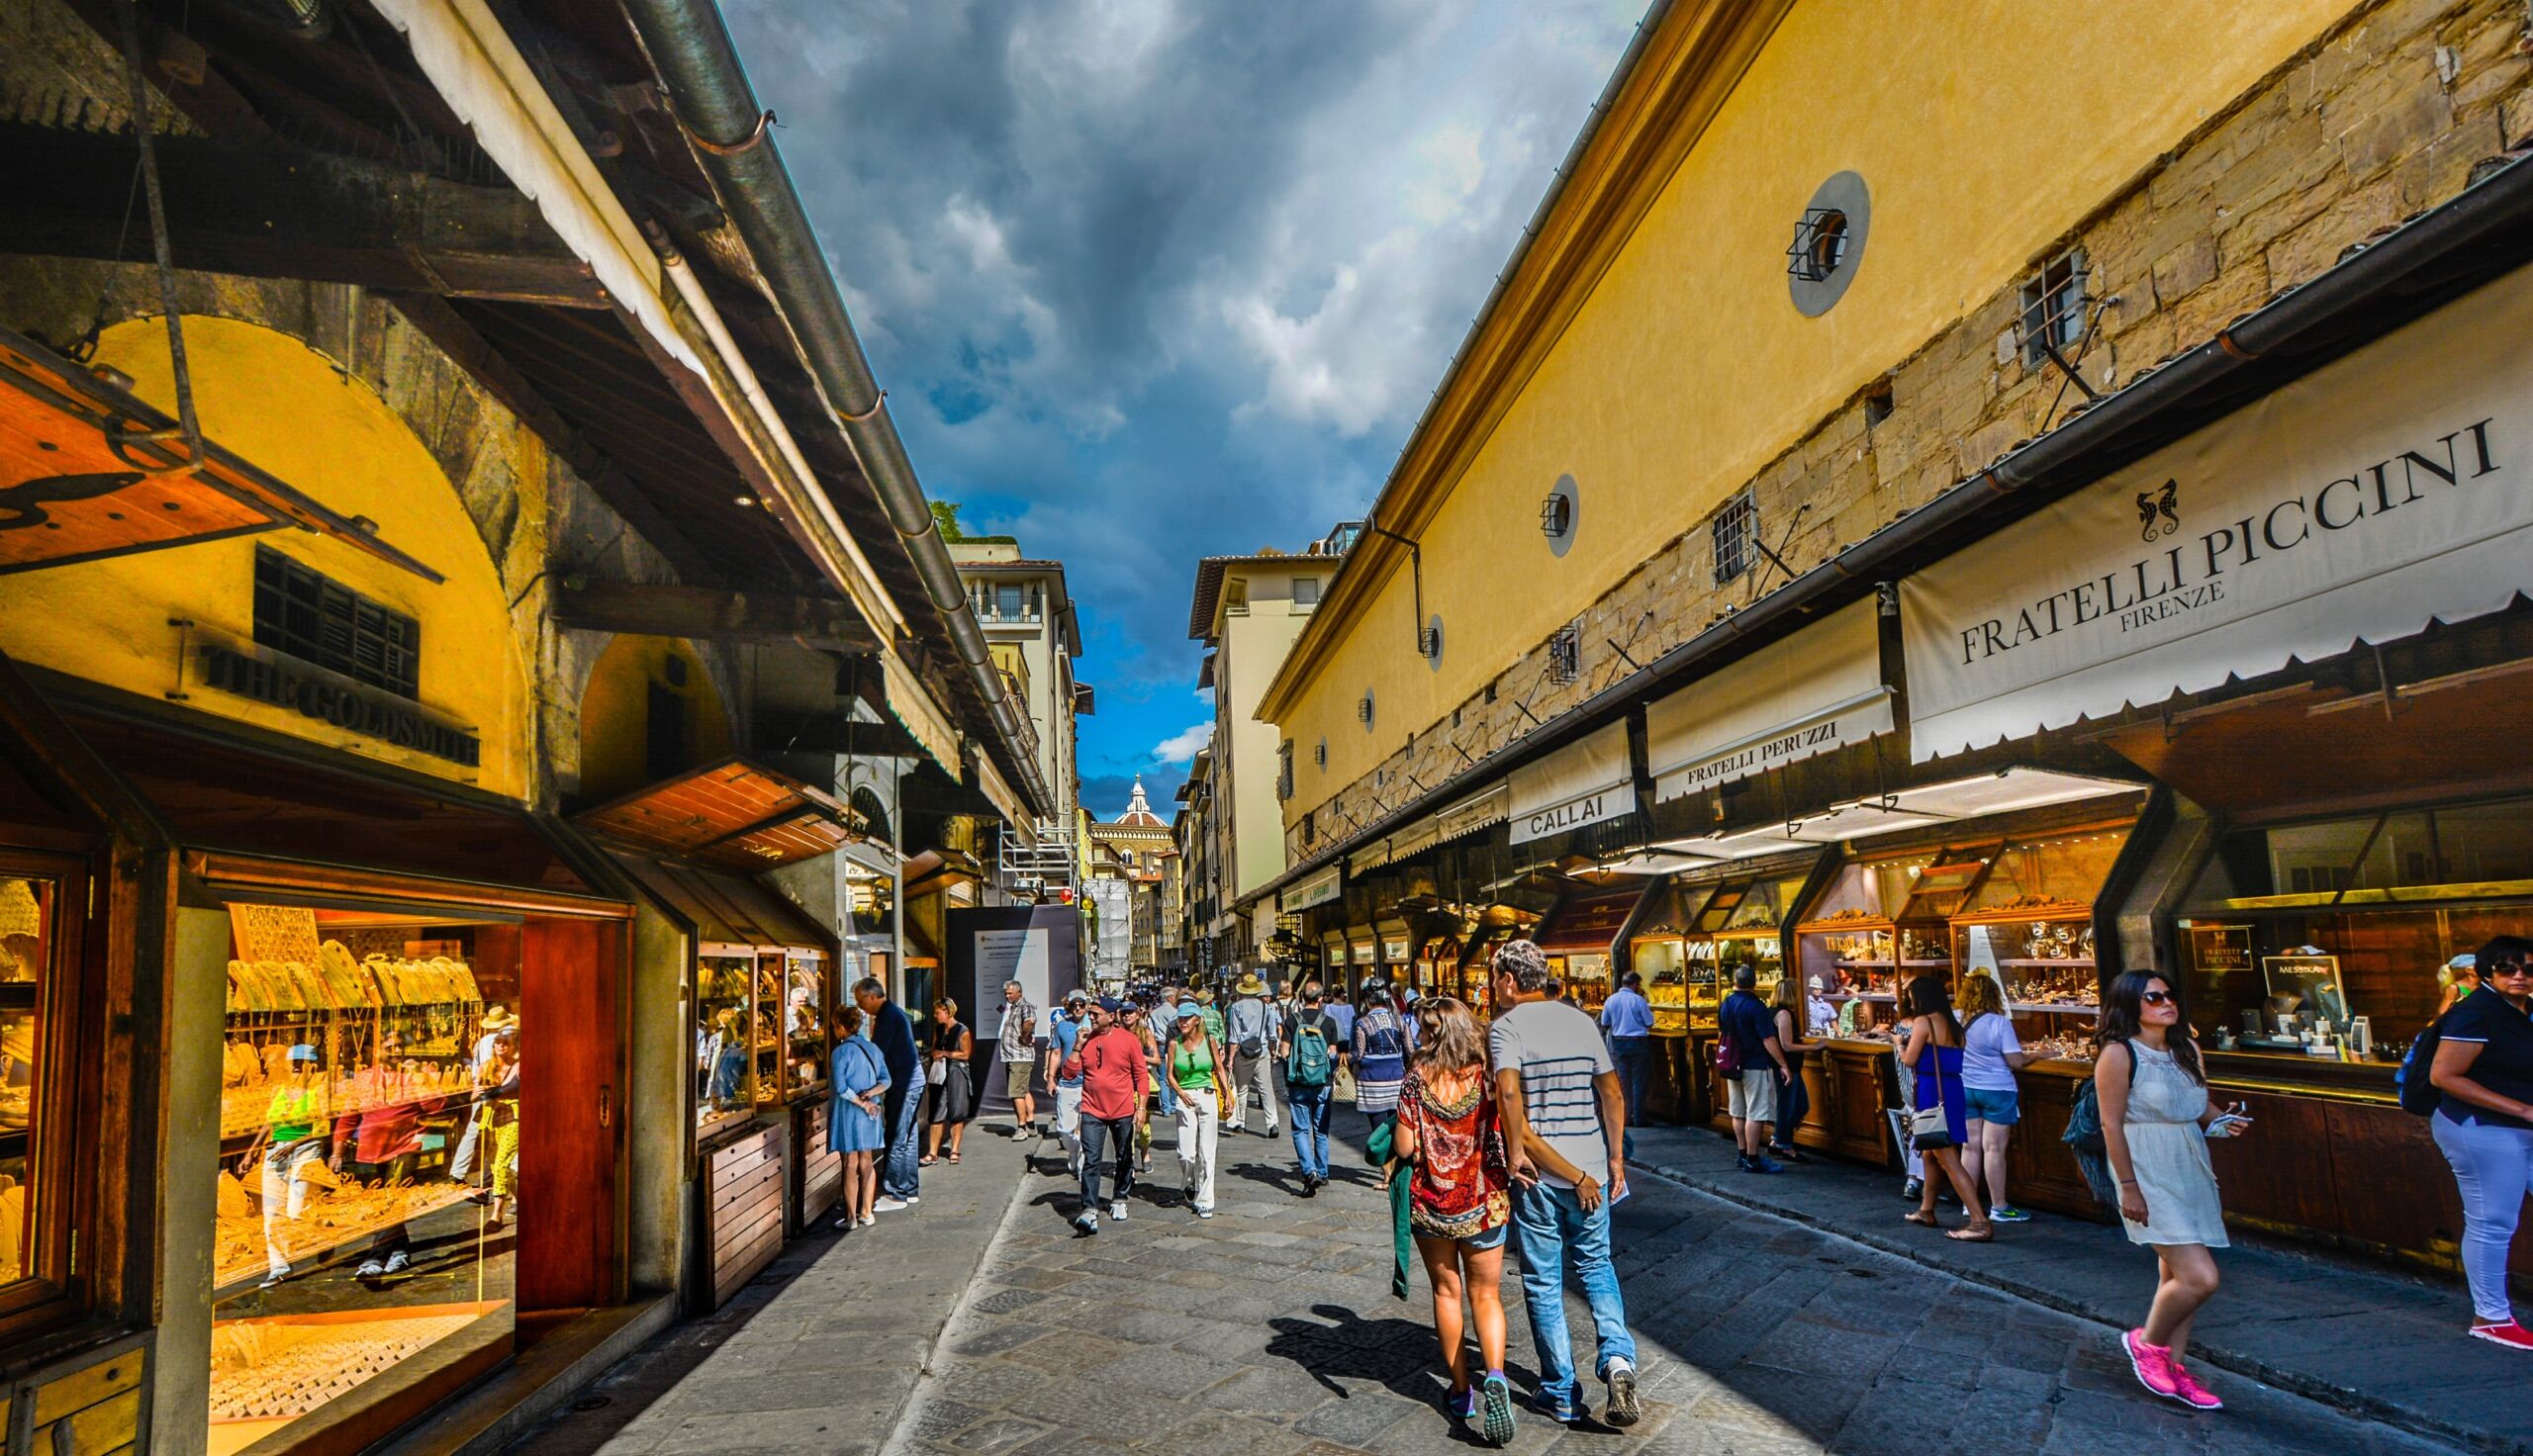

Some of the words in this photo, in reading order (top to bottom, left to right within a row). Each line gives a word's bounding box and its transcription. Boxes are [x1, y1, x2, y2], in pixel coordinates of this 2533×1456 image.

[1959, 546, 2187, 665] FRATELLI
[2201, 417, 2501, 580] PICCINI
[2119, 581, 2224, 633] FIRENZE
[202, 644, 298, 709] THE
[300, 682, 480, 768] GOLDSMITH
[1687, 750, 1755, 785] FRATELLI
[1761, 721, 1837, 761] PERUZZI
[1531, 795, 1603, 835] CALLAI
[2205, 956, 2241, 964] PICCINI
